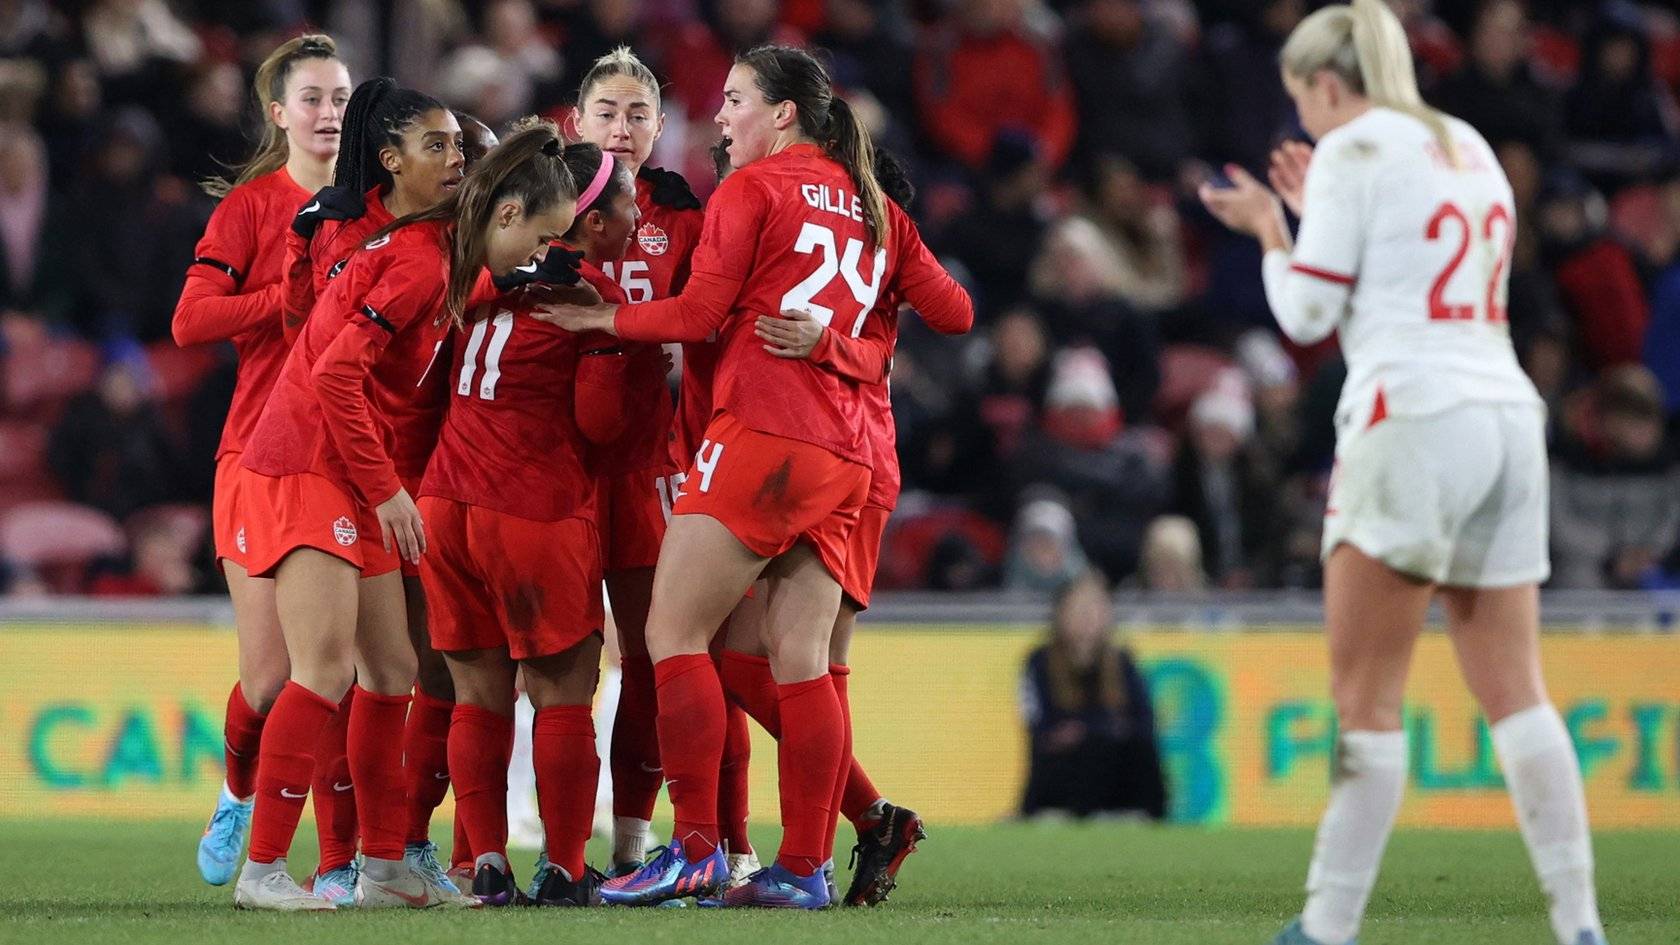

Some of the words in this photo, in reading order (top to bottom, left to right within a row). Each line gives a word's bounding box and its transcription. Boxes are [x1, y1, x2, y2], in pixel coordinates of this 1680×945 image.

[639, 235, 667, 243] CANADA
[801, 184, 865, 223] GILLE
[780, 222, 886, 338] 24
[1425, 202, 1514, 322] 22
[457, 310, 513, 400] 11
